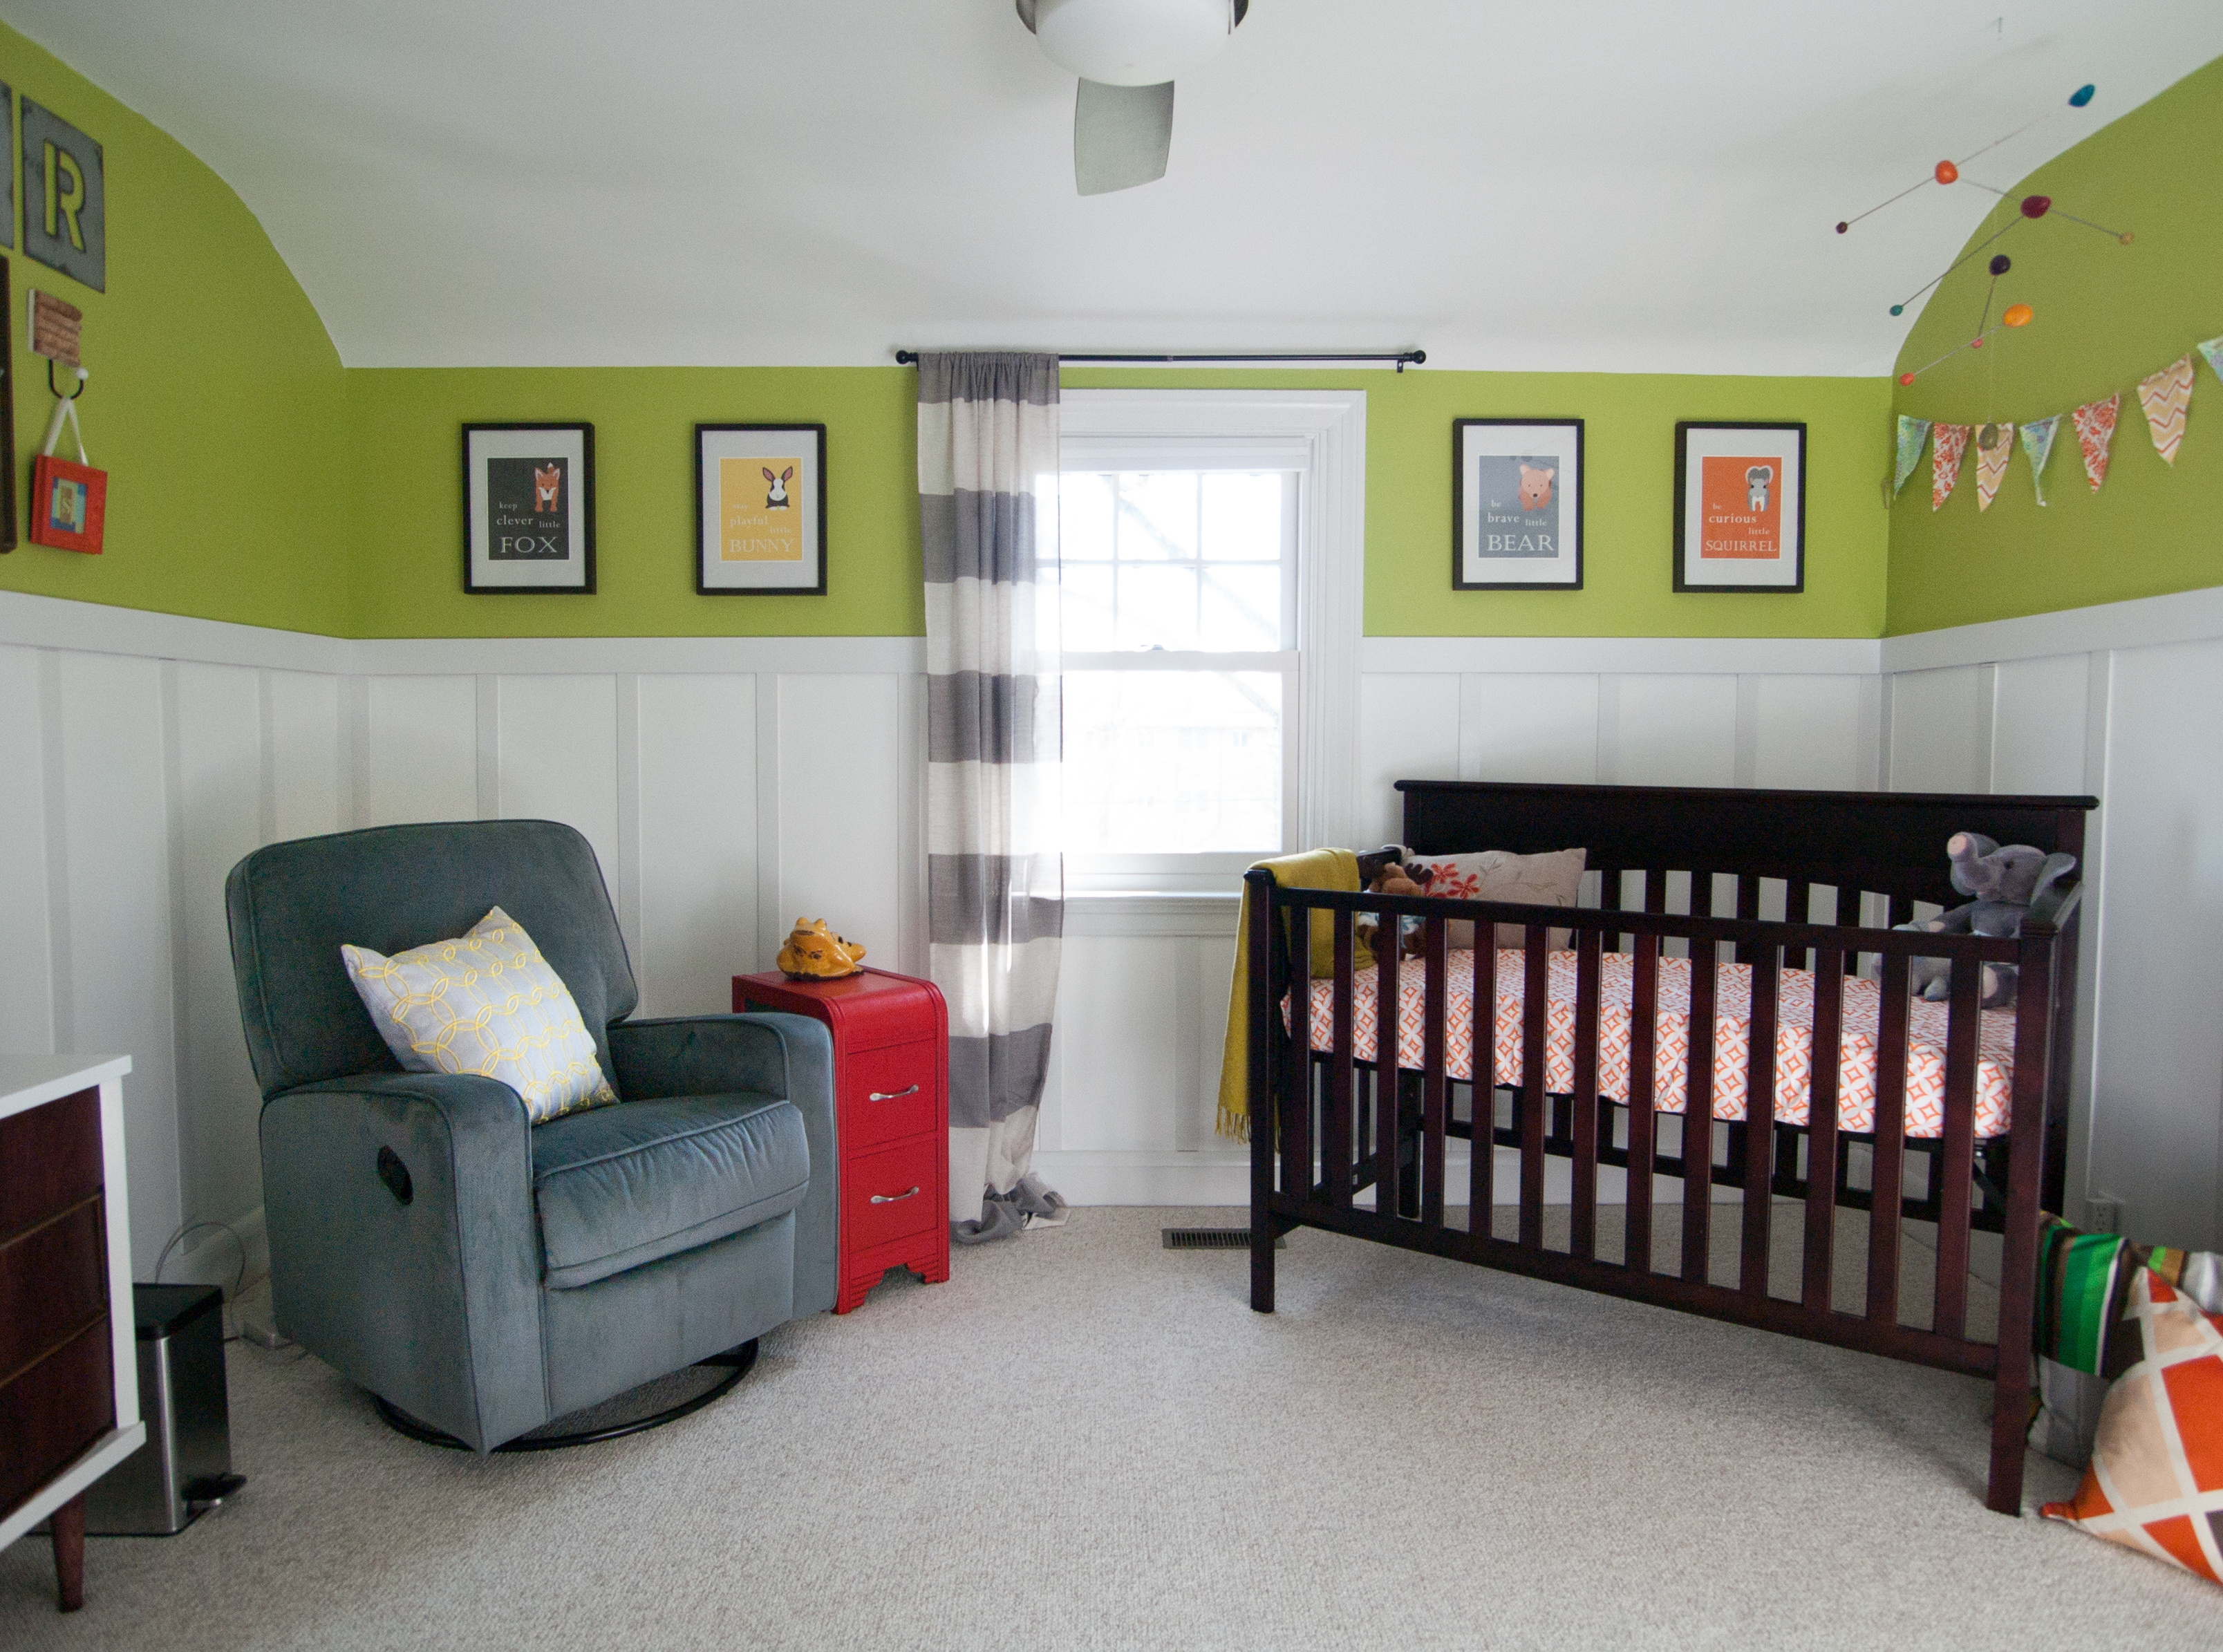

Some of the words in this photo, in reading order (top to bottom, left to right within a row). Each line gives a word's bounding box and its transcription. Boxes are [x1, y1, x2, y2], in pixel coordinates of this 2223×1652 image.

[44, 140, 85, 253] R
[499, 501, 518, 511] keep
[1491, 499, 1501, 508] be
[496, 514, 534, 525] clever
[730, 515, 768, 529] playful
[1488, 512, 1520, 523] brave
[1709, 513, 1756, 523] curious
[500, 536, 557, 553] FOX
[730, 538, 794, 553] BUNNY
[1487, 534, 1554, 551] BEAR
[1705, 540, 1777, 552] SQUIRREL
